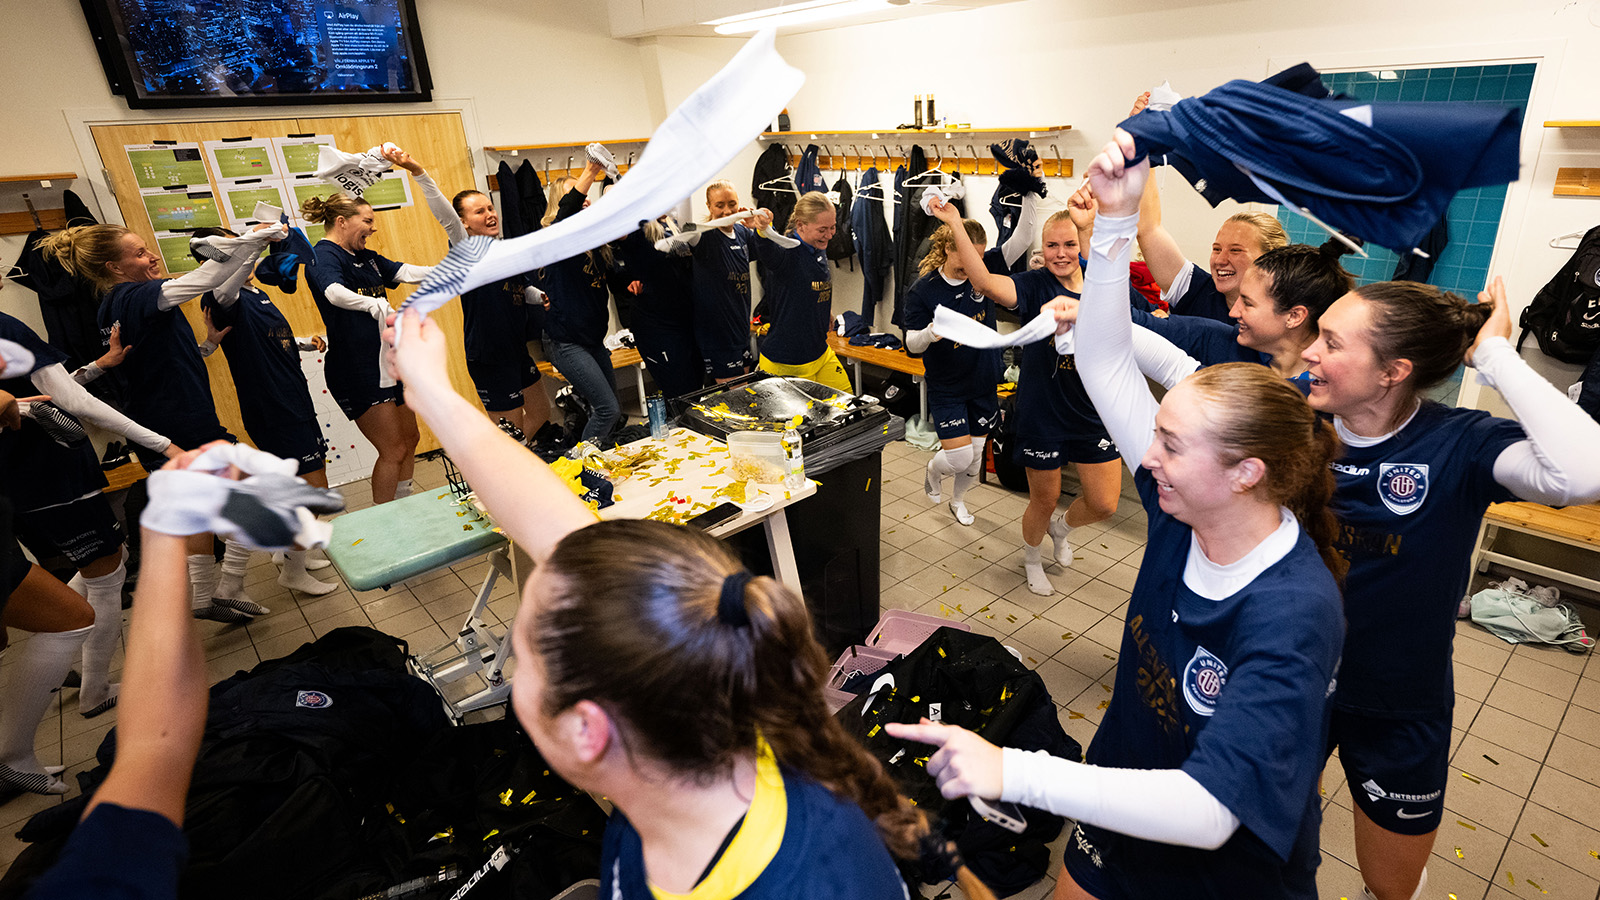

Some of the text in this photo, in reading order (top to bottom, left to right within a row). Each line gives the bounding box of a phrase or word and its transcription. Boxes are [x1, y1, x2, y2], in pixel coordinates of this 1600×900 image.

[338, 12, 359, 20] AirPlay
[334, 173, 364, 196] logis
[662, 351, 668, 362] 1
[1386, 467, 1421, 480] UNITED
[1199, 659, 1227, 686] UNITED
[930, 706, 941, 717] A
[493, 850, 504, 862] 8
